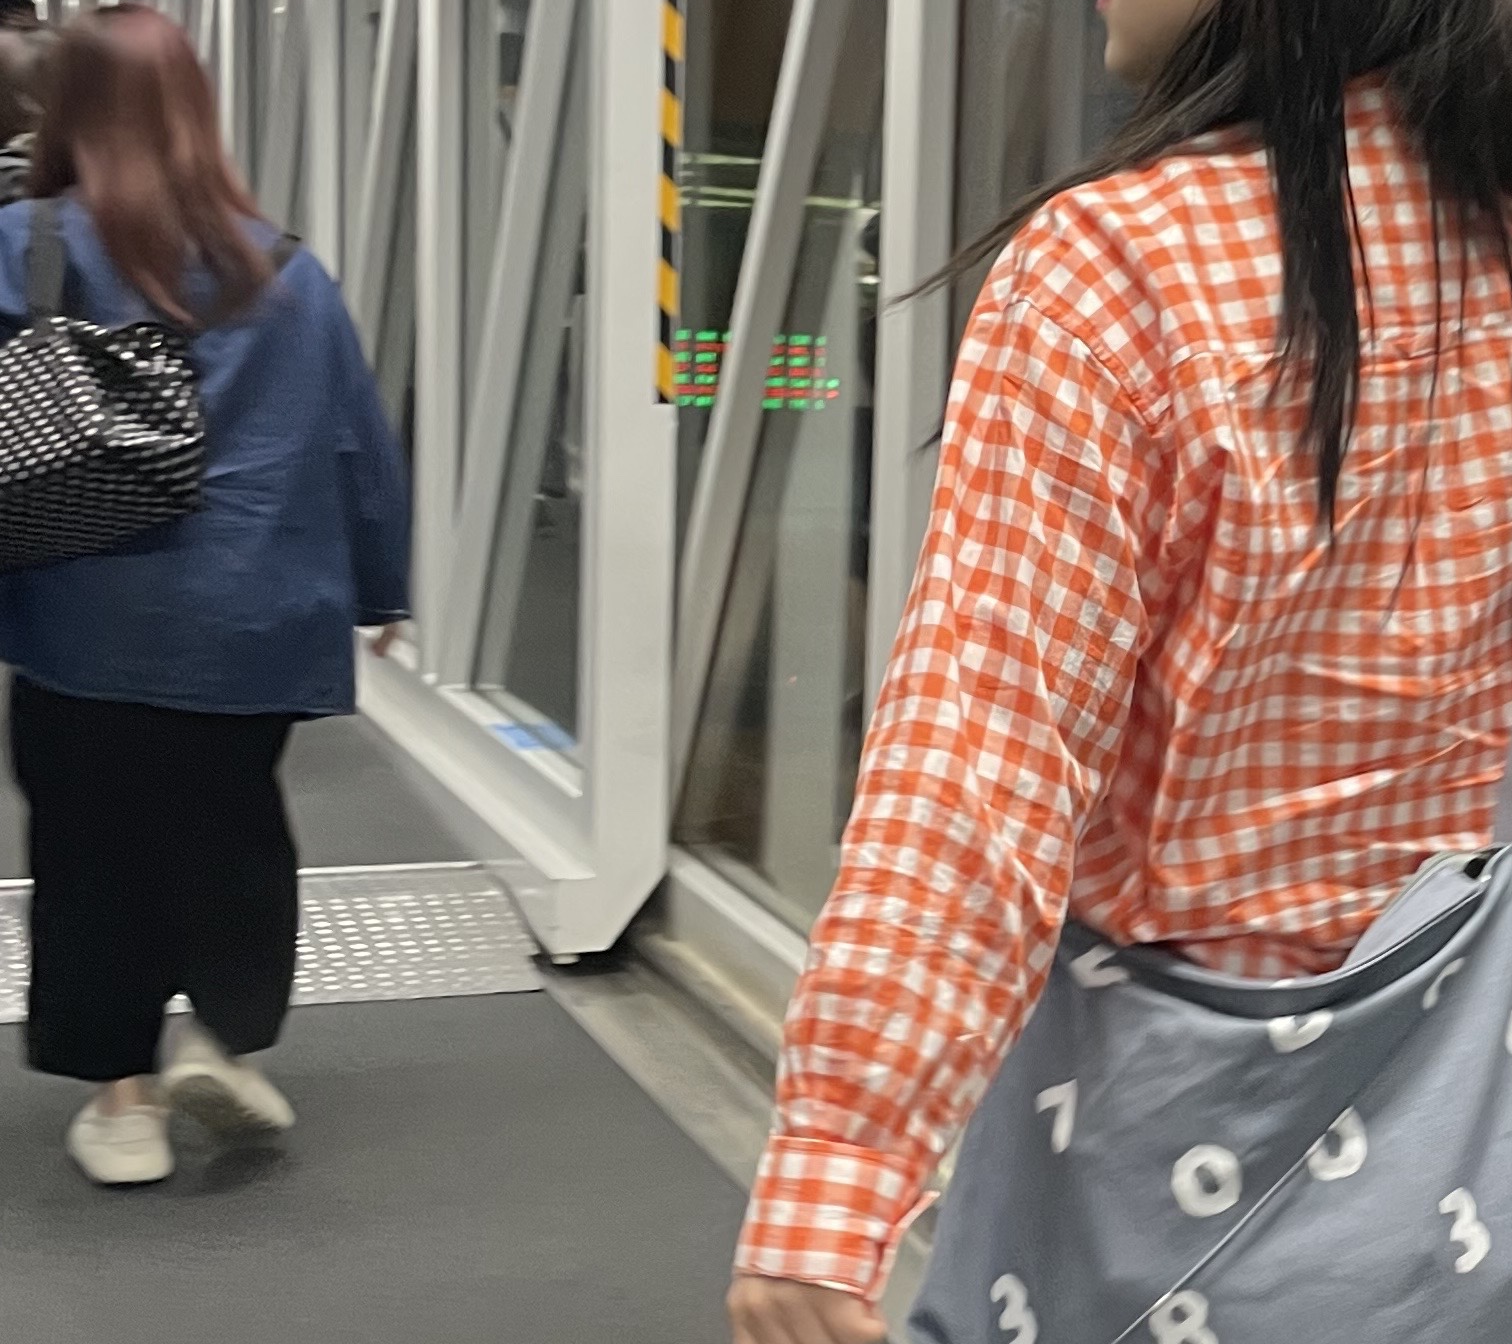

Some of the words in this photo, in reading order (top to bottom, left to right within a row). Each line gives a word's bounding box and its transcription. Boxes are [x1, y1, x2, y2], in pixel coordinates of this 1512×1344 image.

[1035, 1078, 1078, 1154] 7
[1170, 1144, 1243, 1218] 0
[1438, 1186, 1491, 1274] 3
